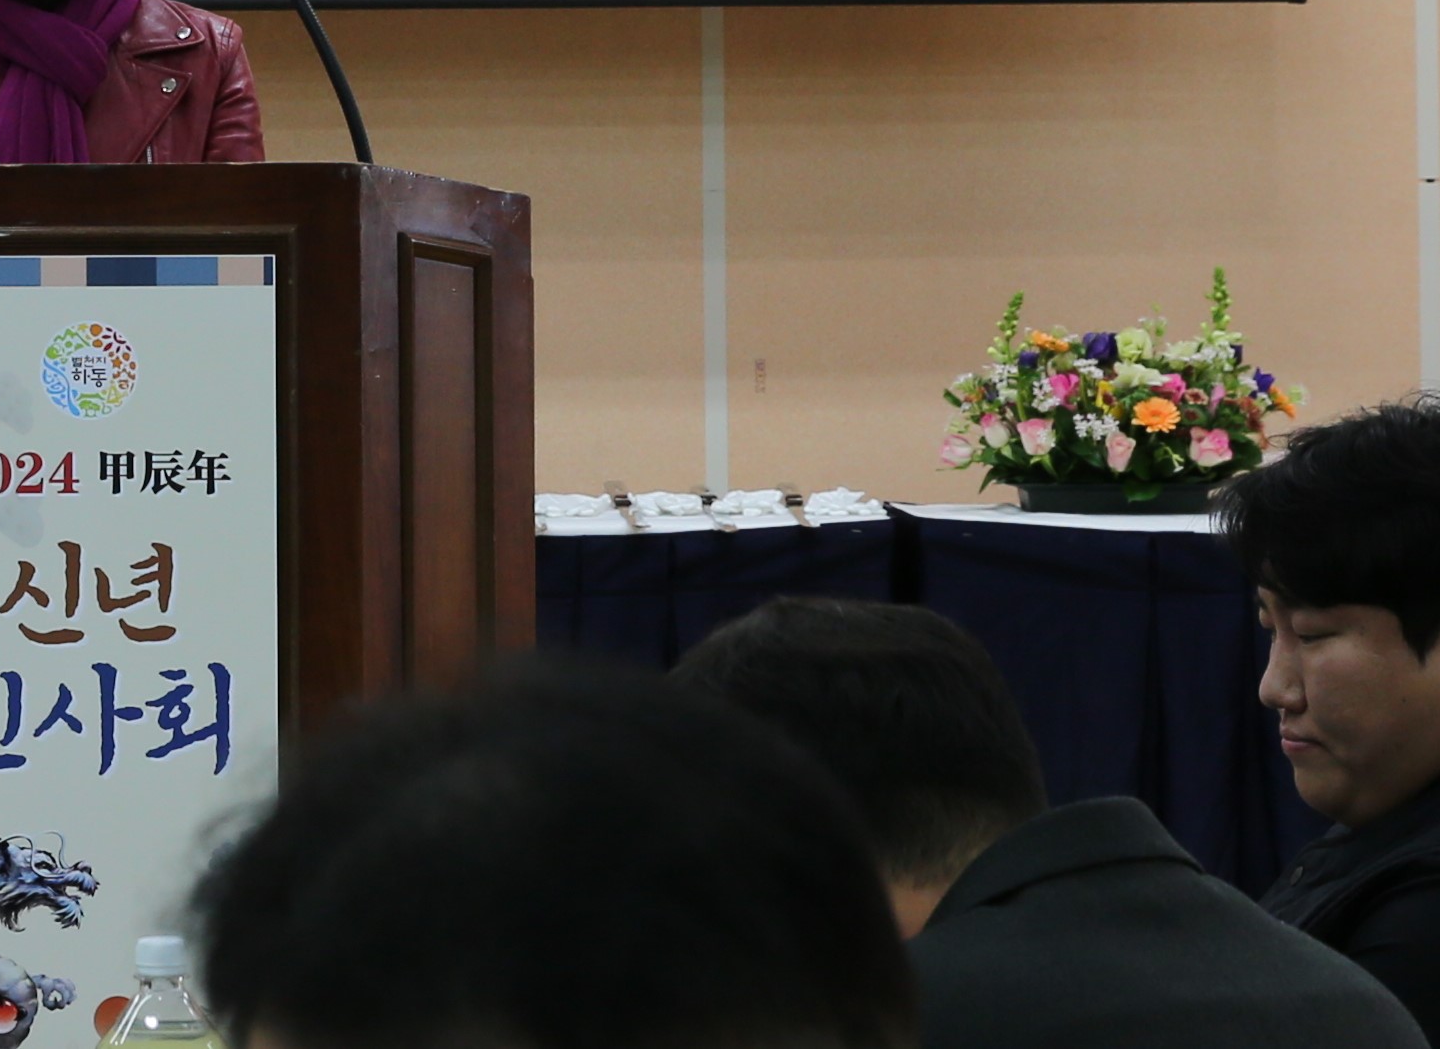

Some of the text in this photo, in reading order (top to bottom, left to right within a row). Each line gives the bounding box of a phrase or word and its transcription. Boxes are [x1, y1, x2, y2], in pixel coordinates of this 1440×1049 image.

[71, 368, 107, 388] 하동
[98, 448, 231, 496] 甲辰年
